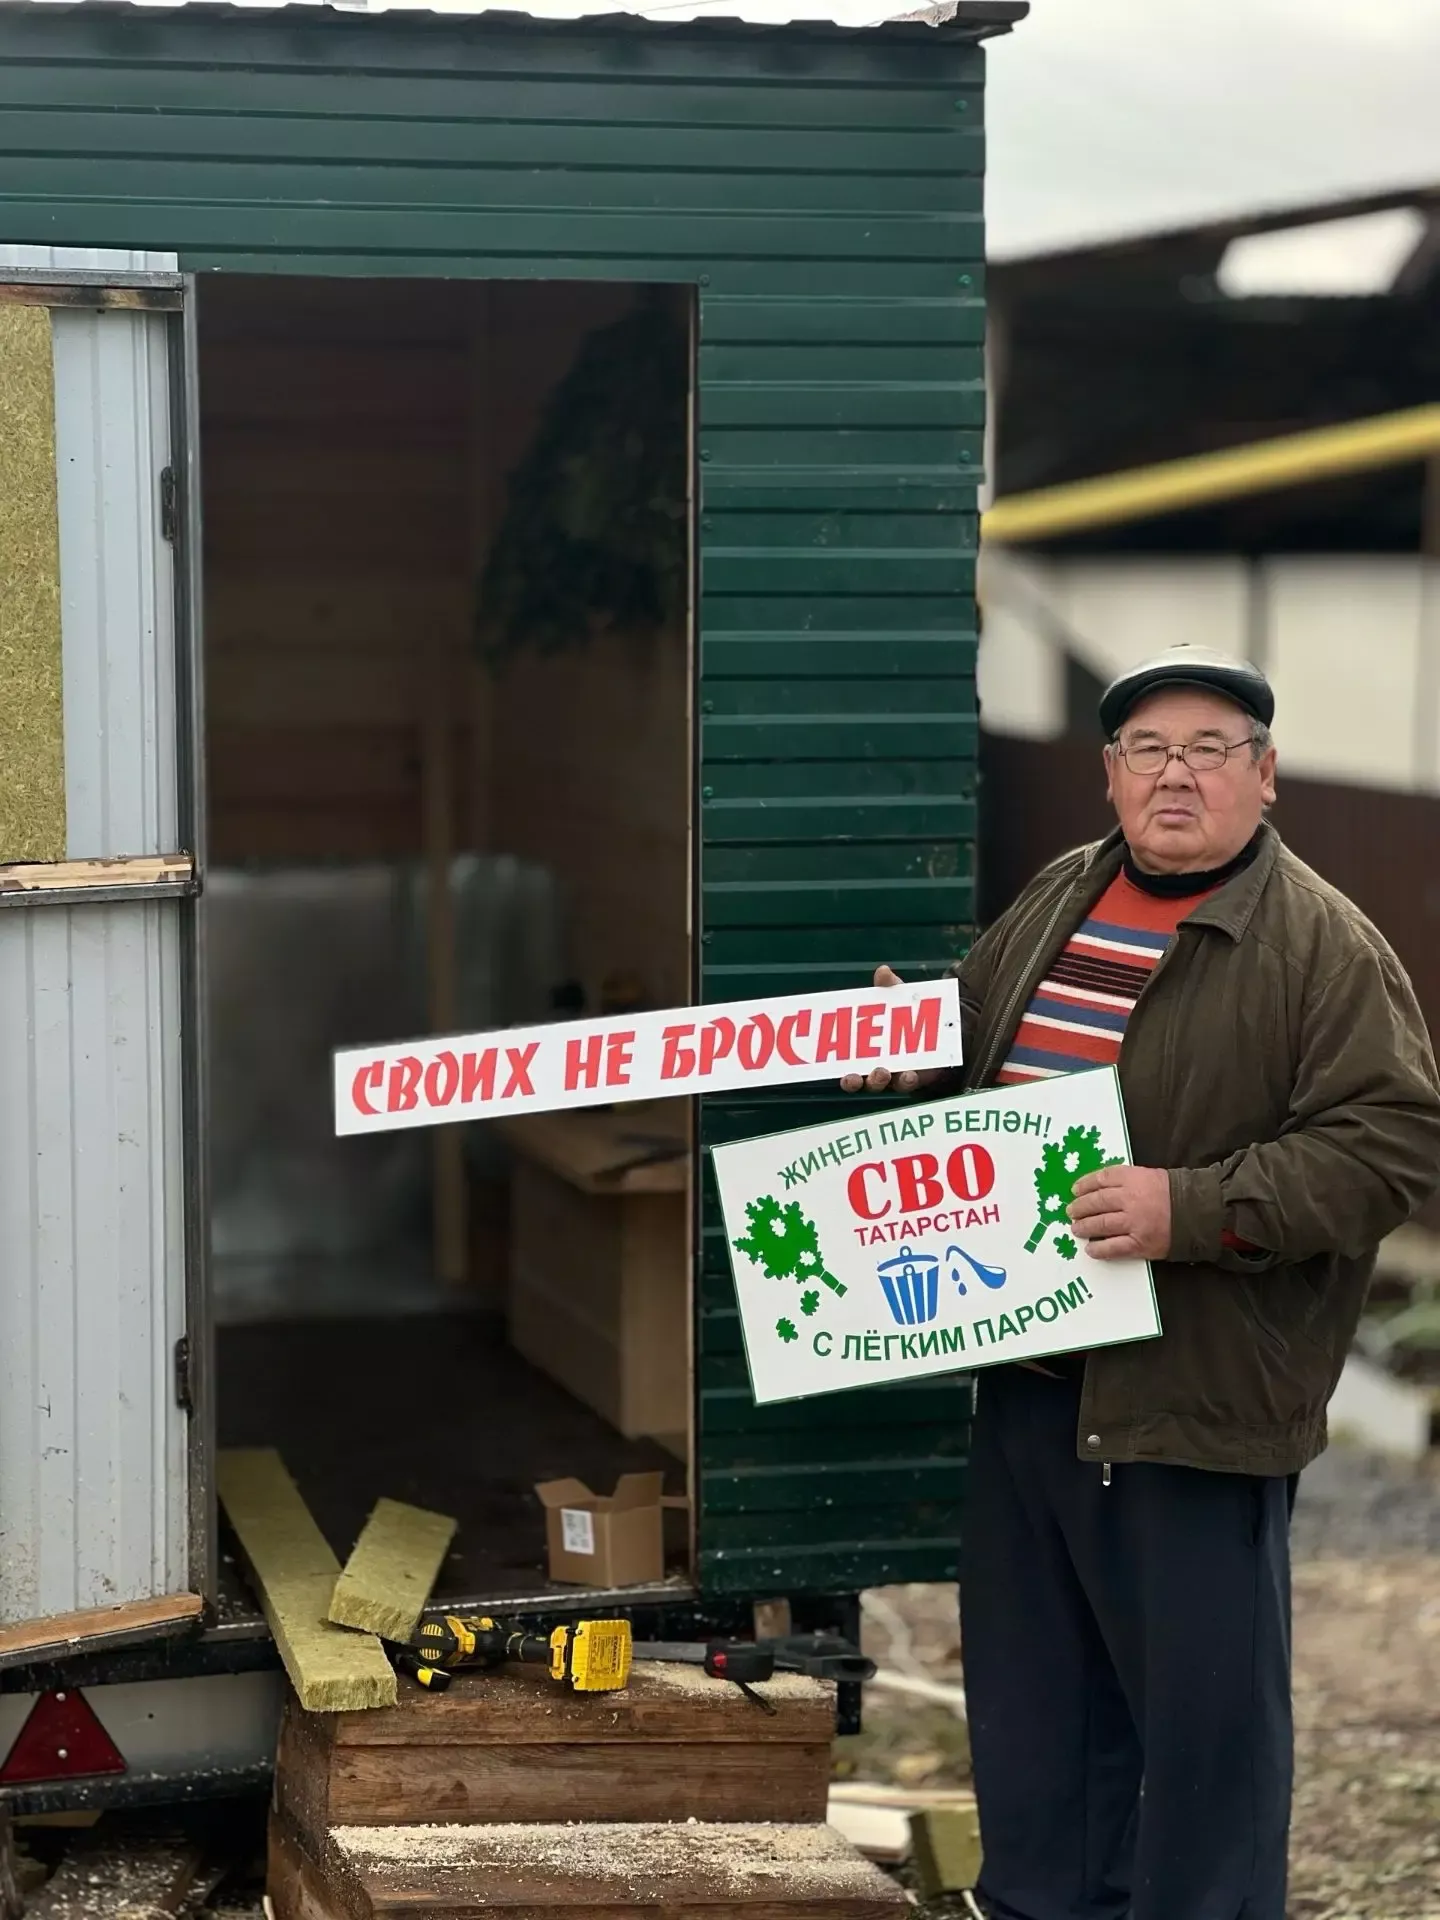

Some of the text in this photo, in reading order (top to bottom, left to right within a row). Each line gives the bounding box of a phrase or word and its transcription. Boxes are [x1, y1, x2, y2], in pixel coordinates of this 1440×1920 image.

[352, 997, 942, 1116] СВОИХ НЕ БРОСАЕМ
[879, 1114, 935, 1145] ПАР
[945, 1109, 1052, 1139] БЕЛӘН!
[847, 1142, 996, 1221] СВО
[854, 1203, 1001, 1247] ТАТАРСТАН
[812, 1275, 1094, 1361] С ЛЁГКИМ ПАРОМ!
